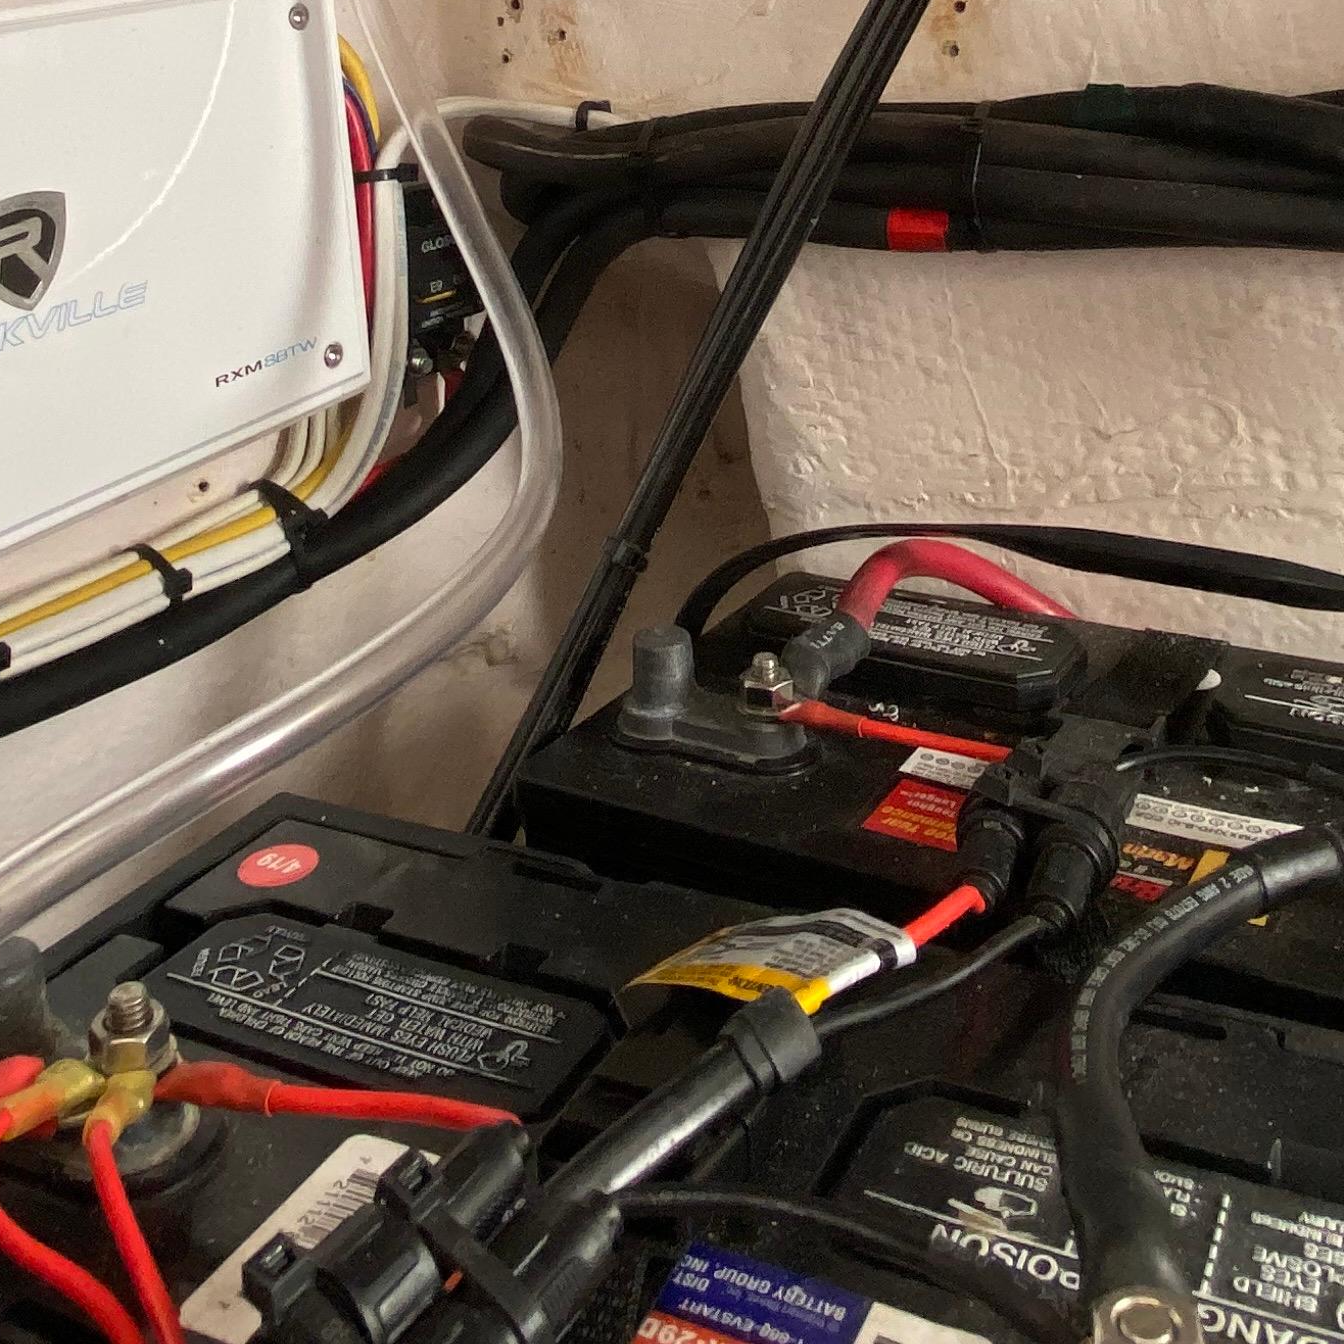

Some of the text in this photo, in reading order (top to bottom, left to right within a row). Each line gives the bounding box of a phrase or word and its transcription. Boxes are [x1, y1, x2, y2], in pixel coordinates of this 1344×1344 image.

[215, 337, 317, 388] RXM8BTW
[256, 852, 302, 874] 4/19
[366, 1008, 395, 1025] GET
[397, 1005, 435, 1023] HELP
[390, 1029, 428, 1049] EYES
[427, 1042, 475, 1063] FLUSH
[446, 1032, 484, 1052] WITH
[903, 1141, 1048, 1192] SULFURIC ACID
[964, 1146, 1053, 1176] CAN CAUSE
[1233, 1276, 1318, 1313] SHIELD
[1260, 1264, 1320, 1295] EYES
[772, 1285, 847, 1322] BATTERY
[678, 1297, 804, 1344] -800-EVSTART
